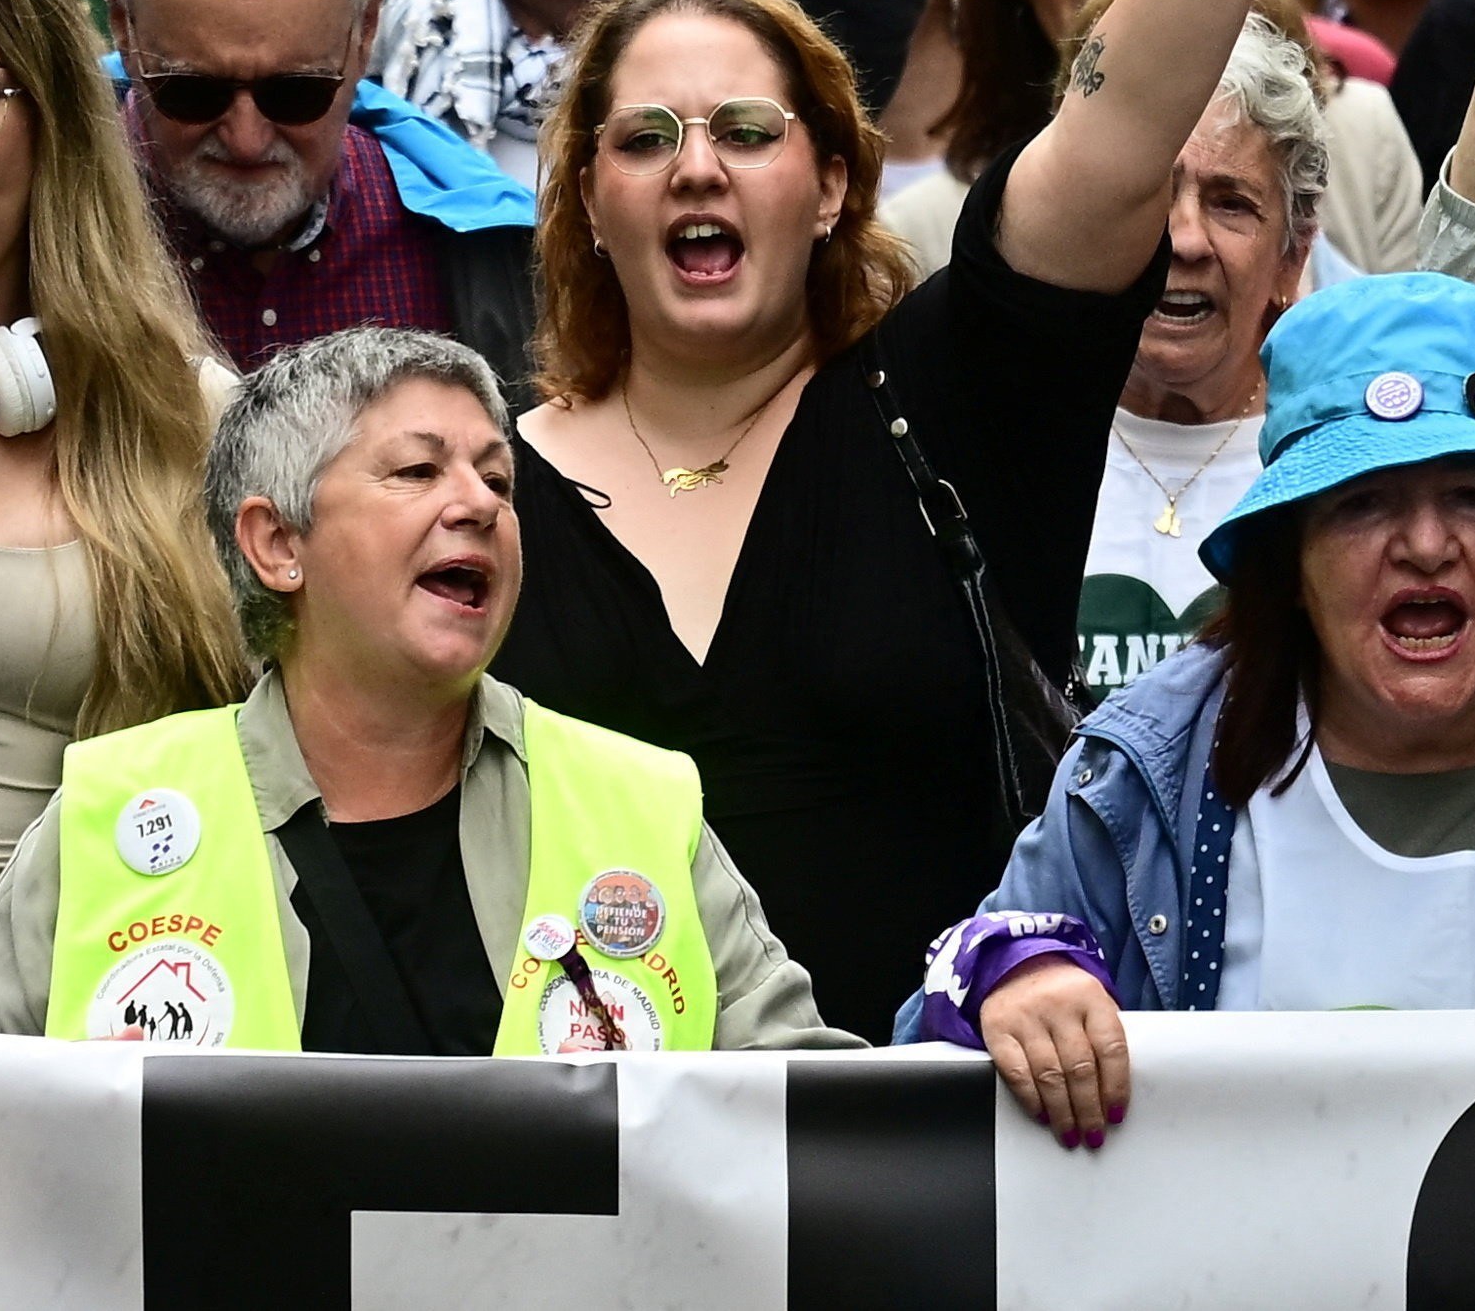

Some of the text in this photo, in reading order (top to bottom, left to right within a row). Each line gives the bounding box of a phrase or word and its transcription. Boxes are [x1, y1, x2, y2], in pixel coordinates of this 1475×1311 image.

[136, 813, 173, 838] 7.291
[108, 914, 222, 952] COESPE
[613, 975, 631, 989] DE
[630, 986, 661, 1031] MADRID
